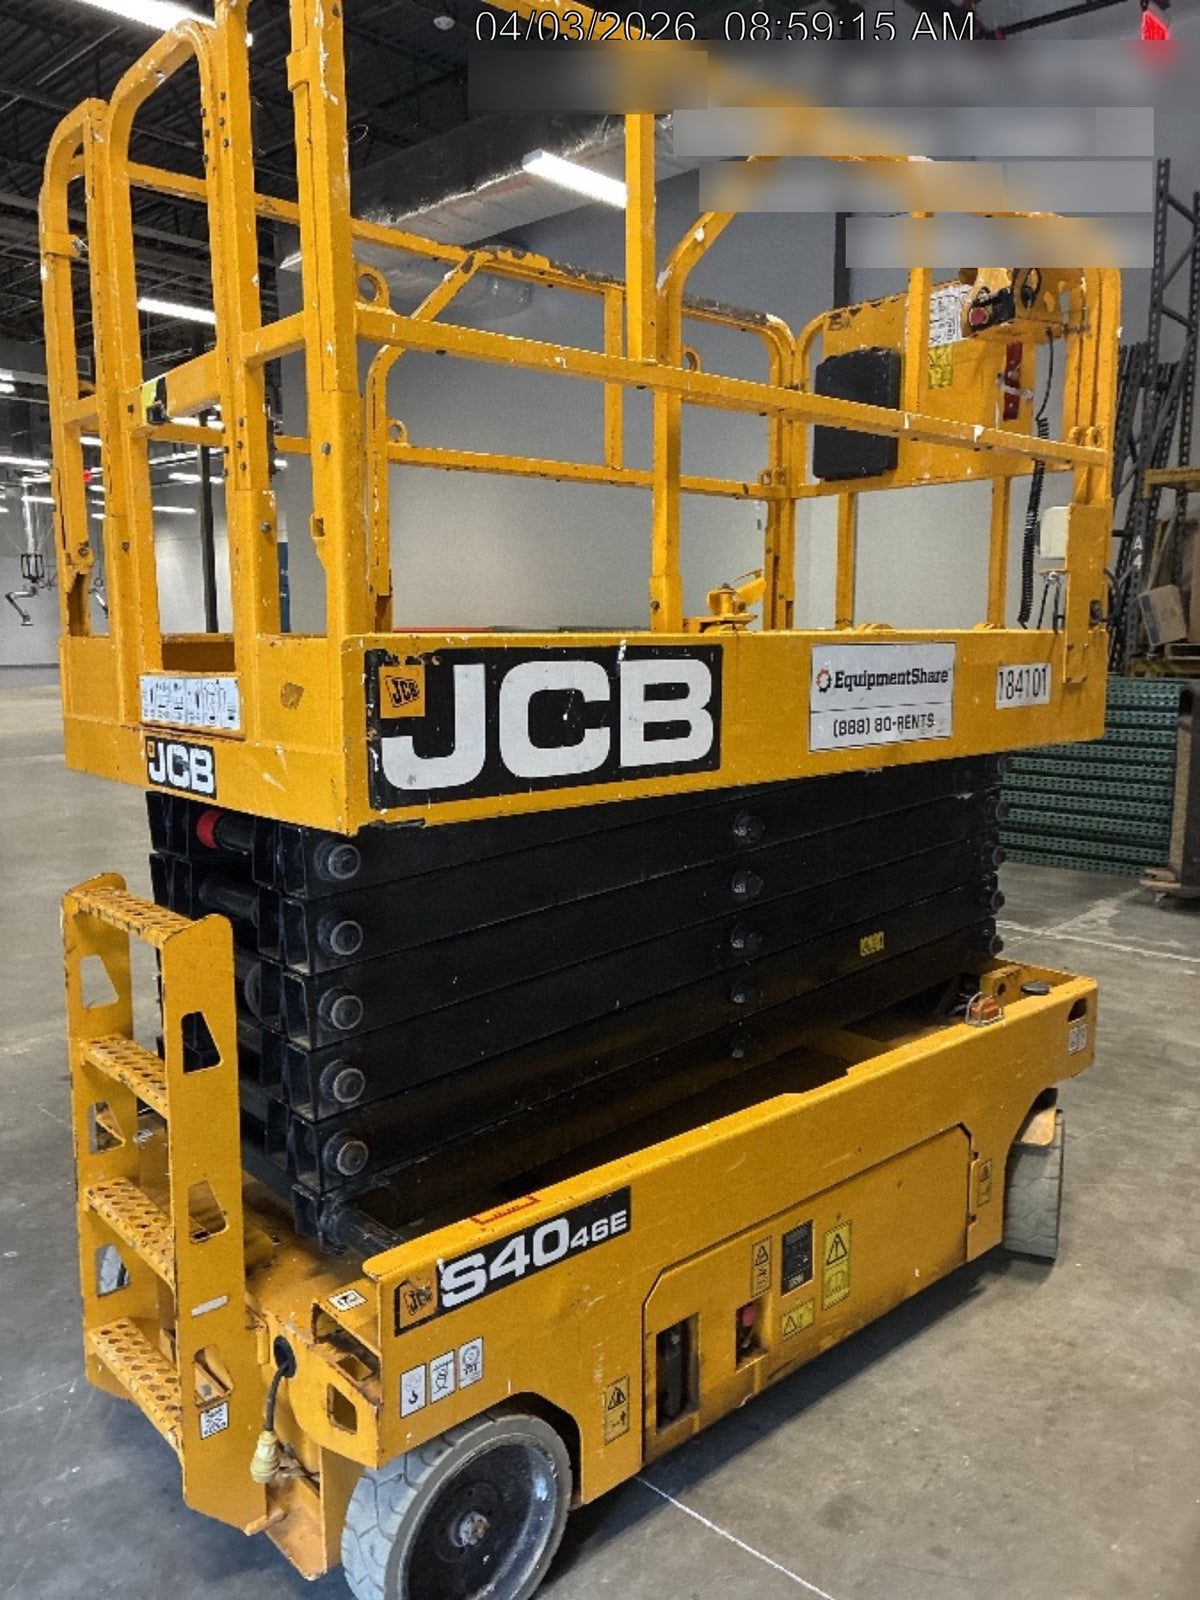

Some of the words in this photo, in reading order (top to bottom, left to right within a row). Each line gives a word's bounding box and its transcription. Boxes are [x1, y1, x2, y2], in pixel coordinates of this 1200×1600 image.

[833, 667, 951, 692] EquipmentShare
[998, 667, 1047, 701] 184101
[381, 659, 714, 790] JCB
[833, 717, 870, 738] (888)
[874, 713, 935, 733] 80-RENTS
[148, 742, 214, 794] JCB
